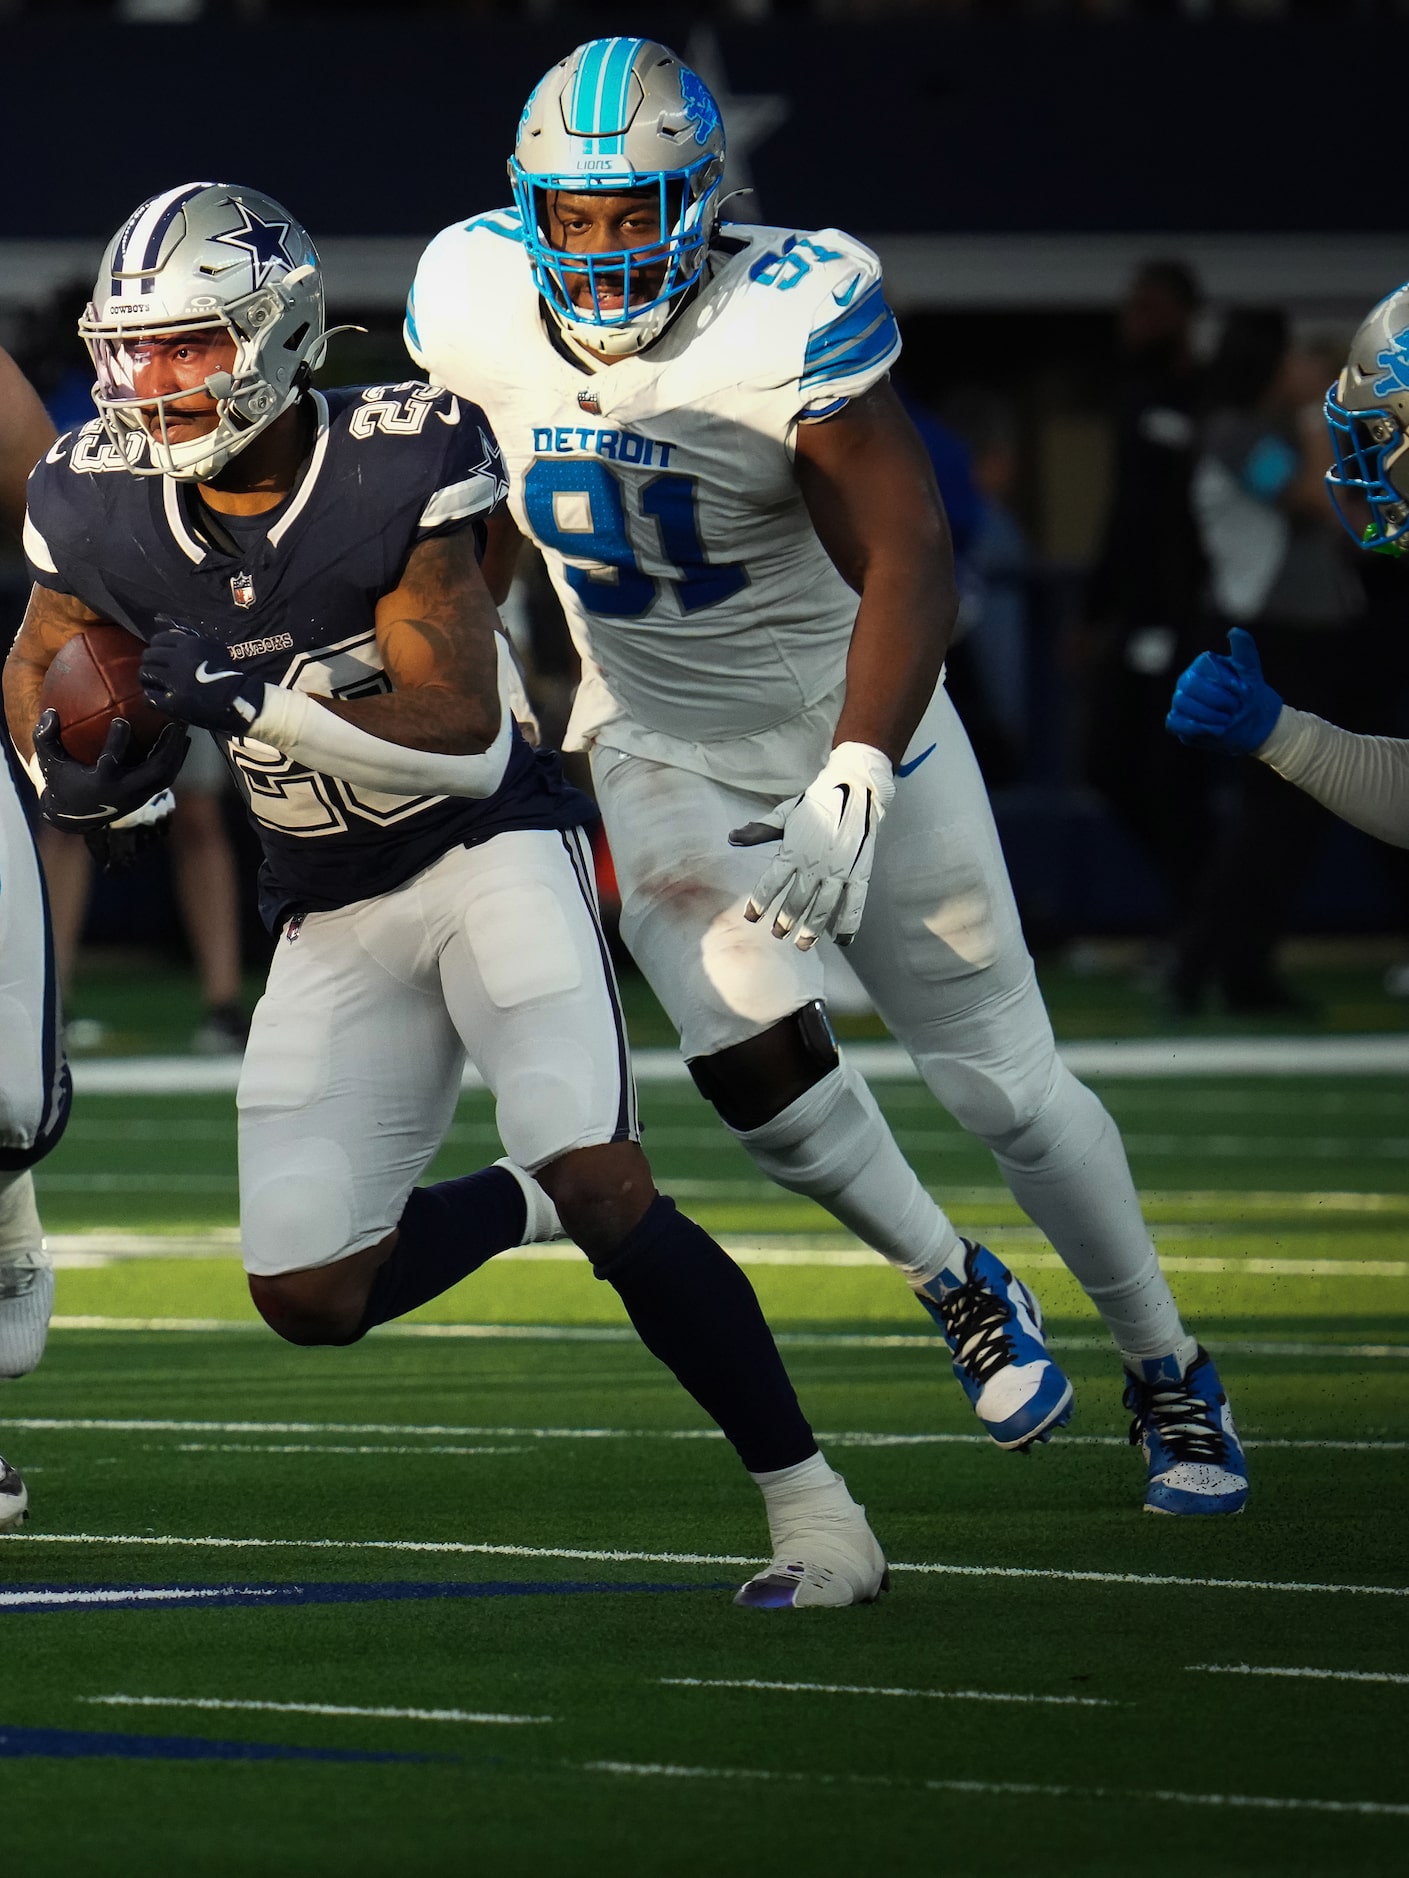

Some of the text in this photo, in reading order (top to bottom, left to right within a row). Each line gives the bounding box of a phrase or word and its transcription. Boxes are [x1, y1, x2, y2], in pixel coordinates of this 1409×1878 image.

[749, 233, 844, 291] 91
[110, 303, 151, 315] COWBOYS
[348, 380, 446, 440] 23
[532, 427, 678, 468] DETROIT
[521, 455, 752, 620] 91
